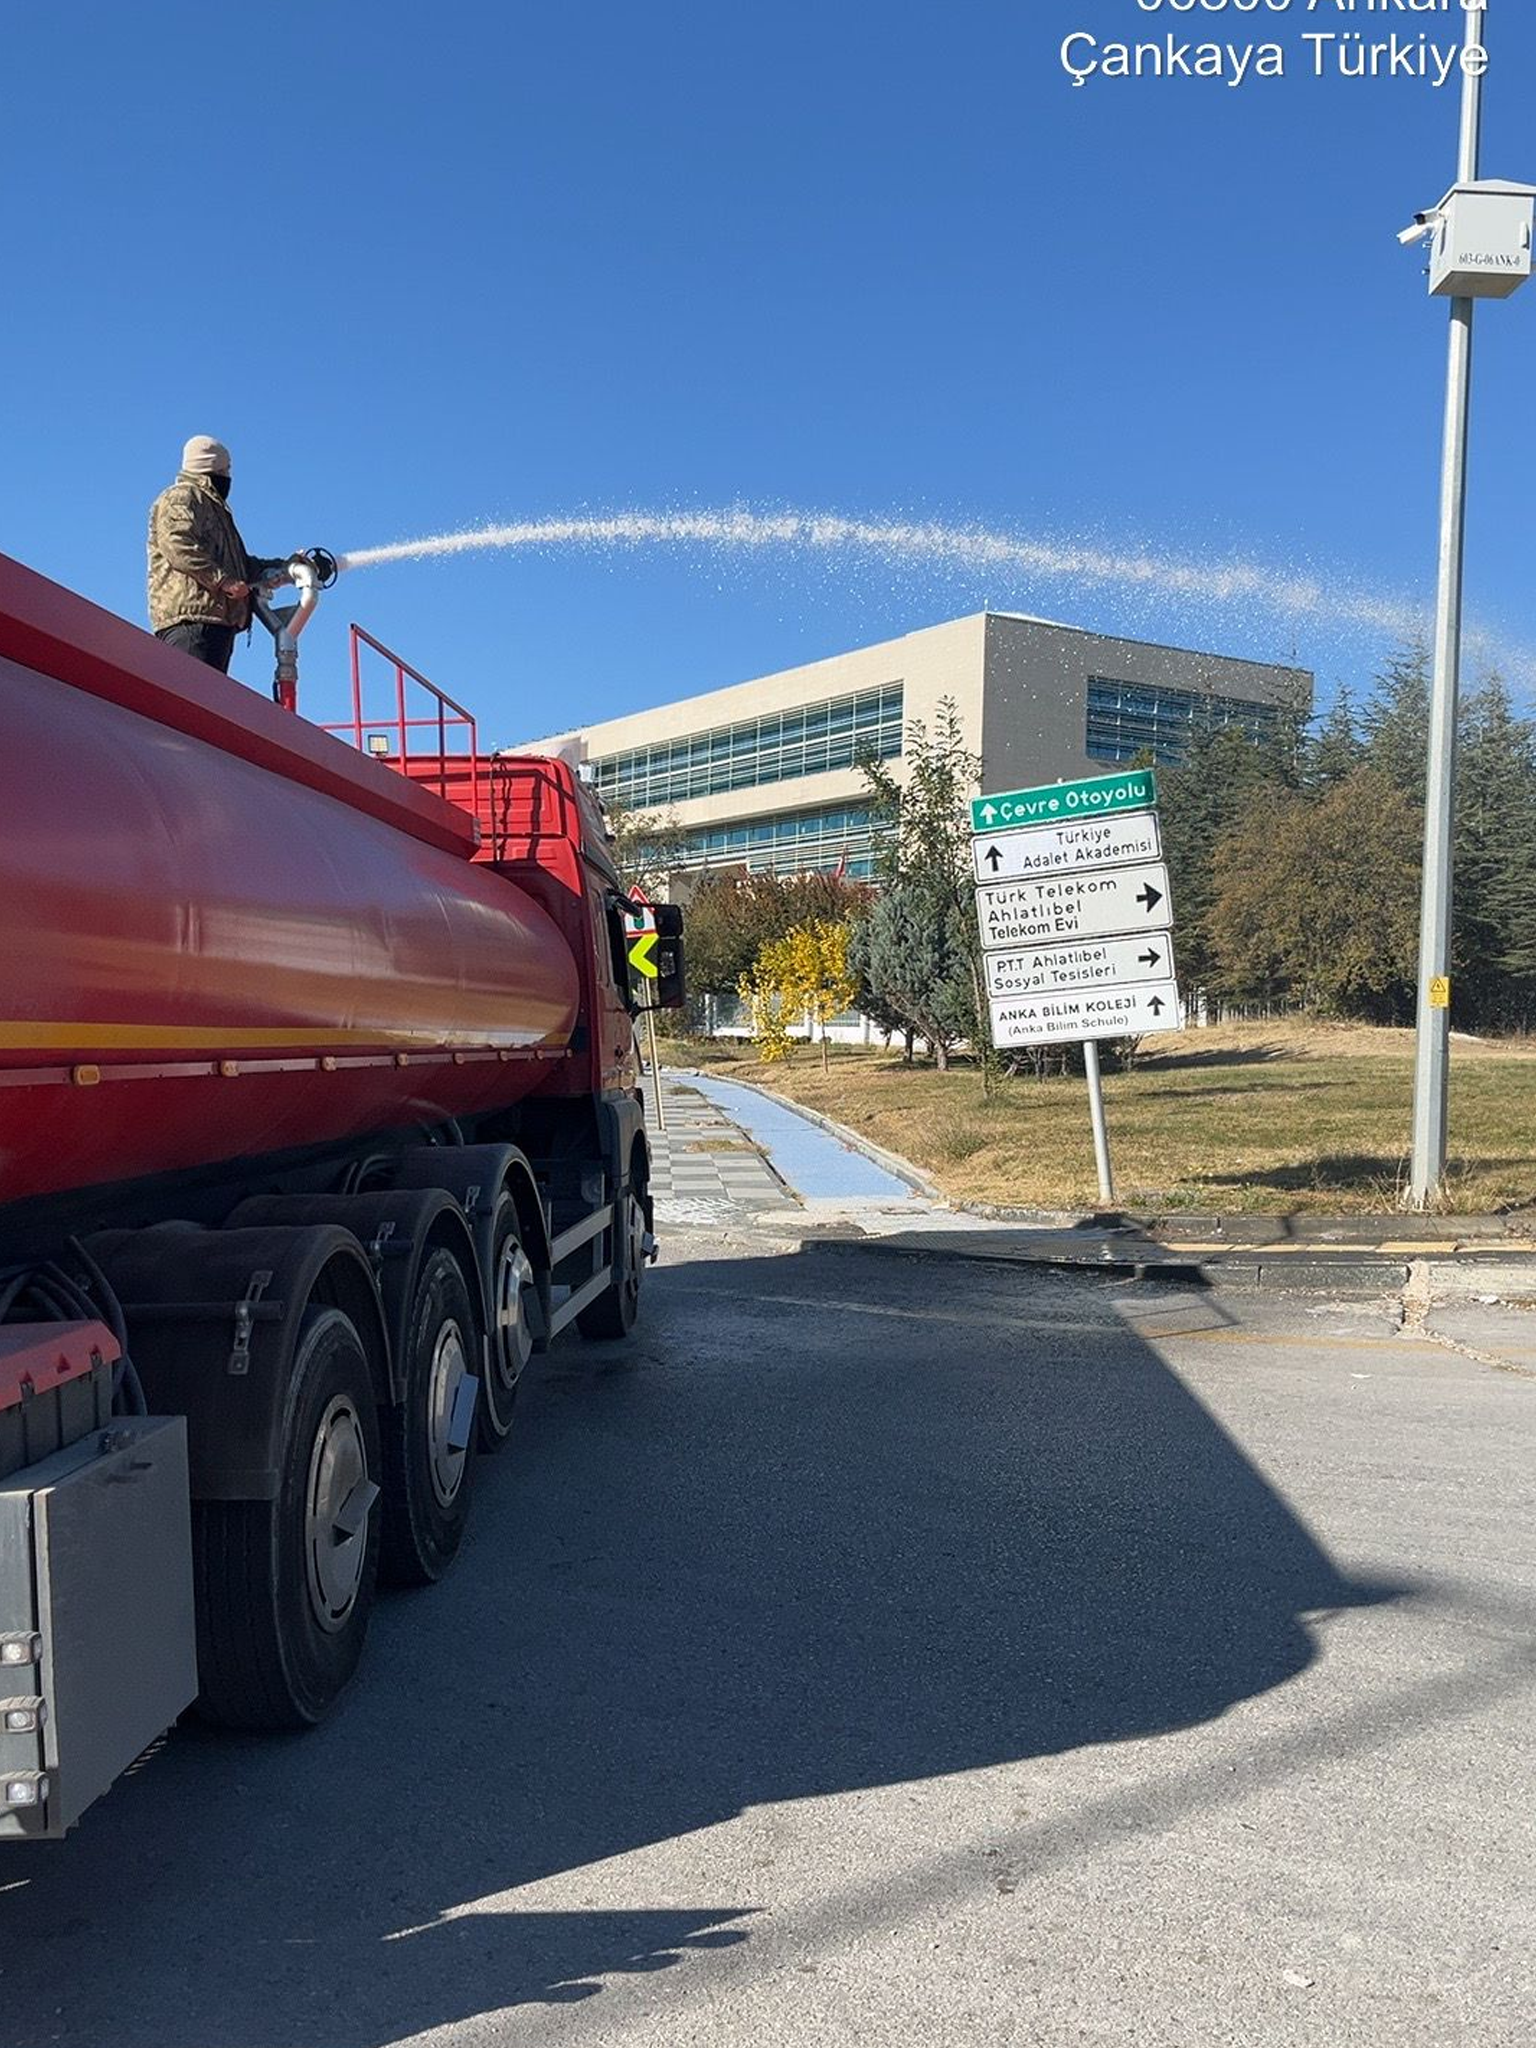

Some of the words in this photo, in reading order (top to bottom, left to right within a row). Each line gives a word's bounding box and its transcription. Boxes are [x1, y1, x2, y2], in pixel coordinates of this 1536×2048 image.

[1000, 797, 1060, 820] Çevre
[1065, 782, 1146, 809] Otoyolu
[1056, 827, 1111, 846] Türkiye
[1023, 849, 1069, 870] Adalet
[1075, 840, 1152, 862] Akademisi
[985, 889, 1027, 906] Türk
[1035, 879, 1117, 899] Telekom
[989, 921, 1051, 941] Telekom
[1055, 916, 1079, 932] Evi
[993, 972, 1045, 991] Sosyal
[1050, 963, 1117, 983] Tesisleri
[999, 1008, 1038, 1022] ANKA
[1042, 1002, 1080, 1017] BİLİM
[1086, 995, 1137, 1013] KOLEJİ
[1008, 1023, 1044, 1037] (Anka
[1081, 1015, 1129, 1029] Schule)
